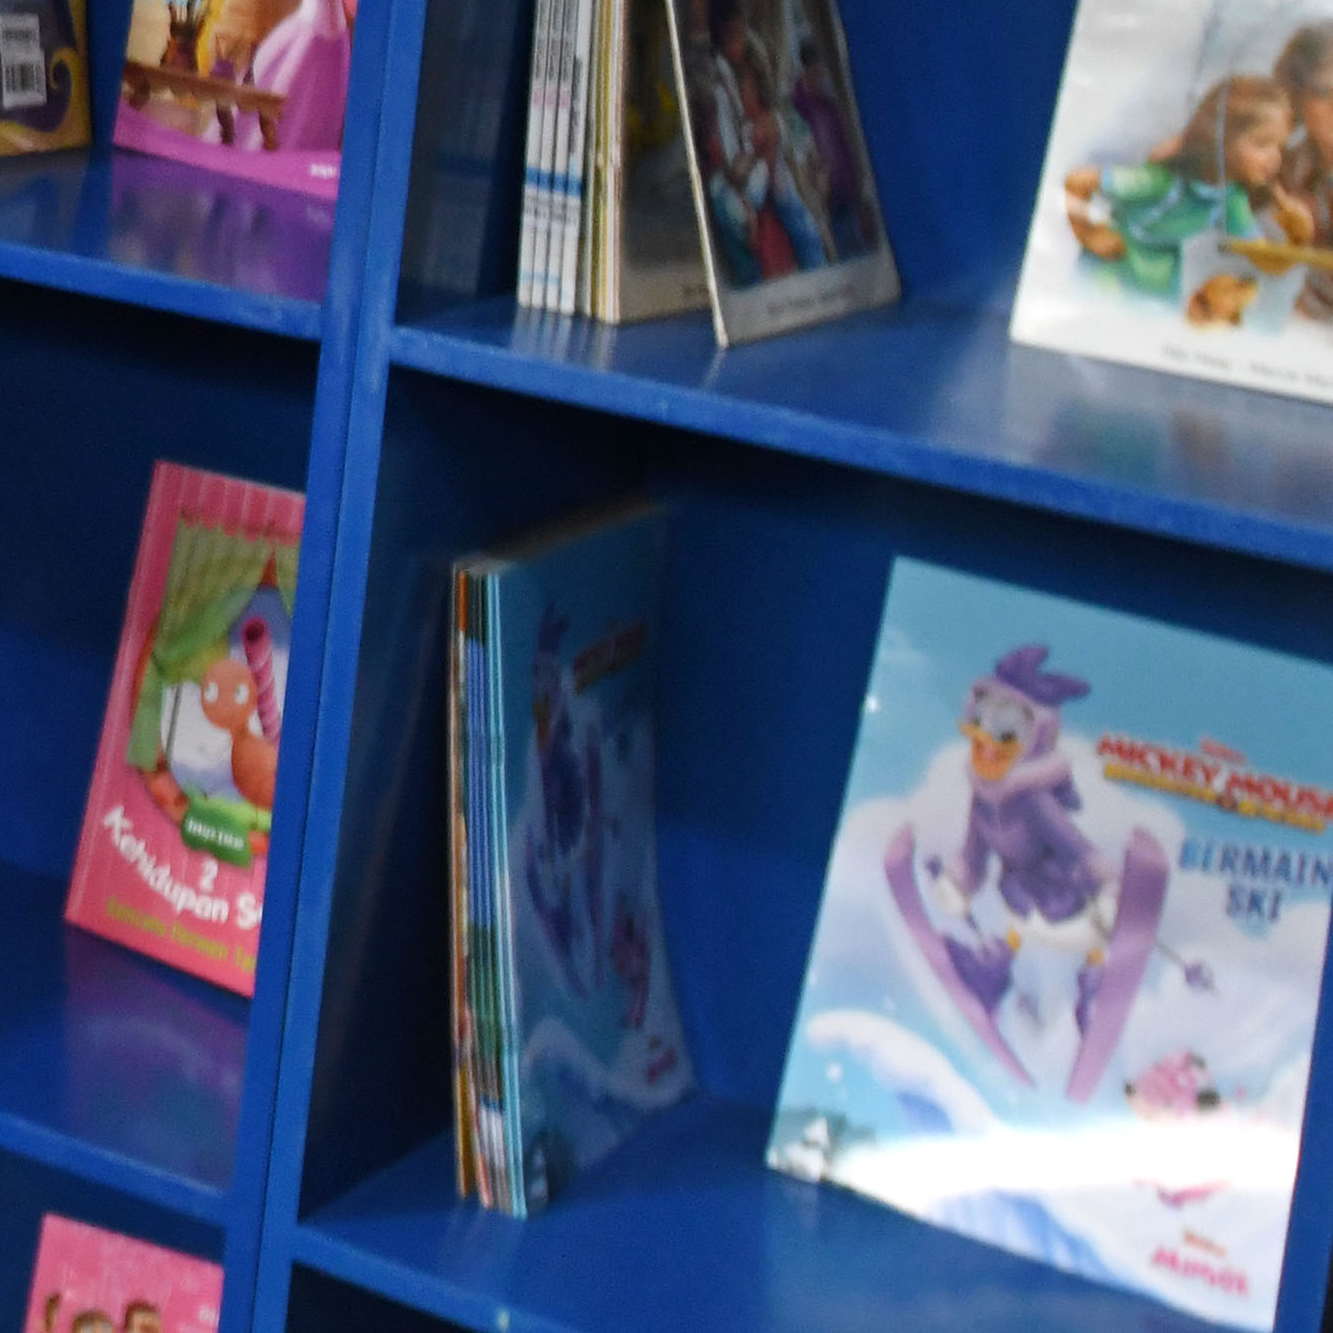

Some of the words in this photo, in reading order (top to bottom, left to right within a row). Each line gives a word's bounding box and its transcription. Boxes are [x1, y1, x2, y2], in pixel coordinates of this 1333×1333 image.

[1097, 733, 1222, 784] MICKEY
[104, 805, 229, 924] Kehidupan
[199, 857, 219, 892] 2
[1179, 838, 1333, 886] BERMAIN
[1226, 882, 1282, 922] SKI
